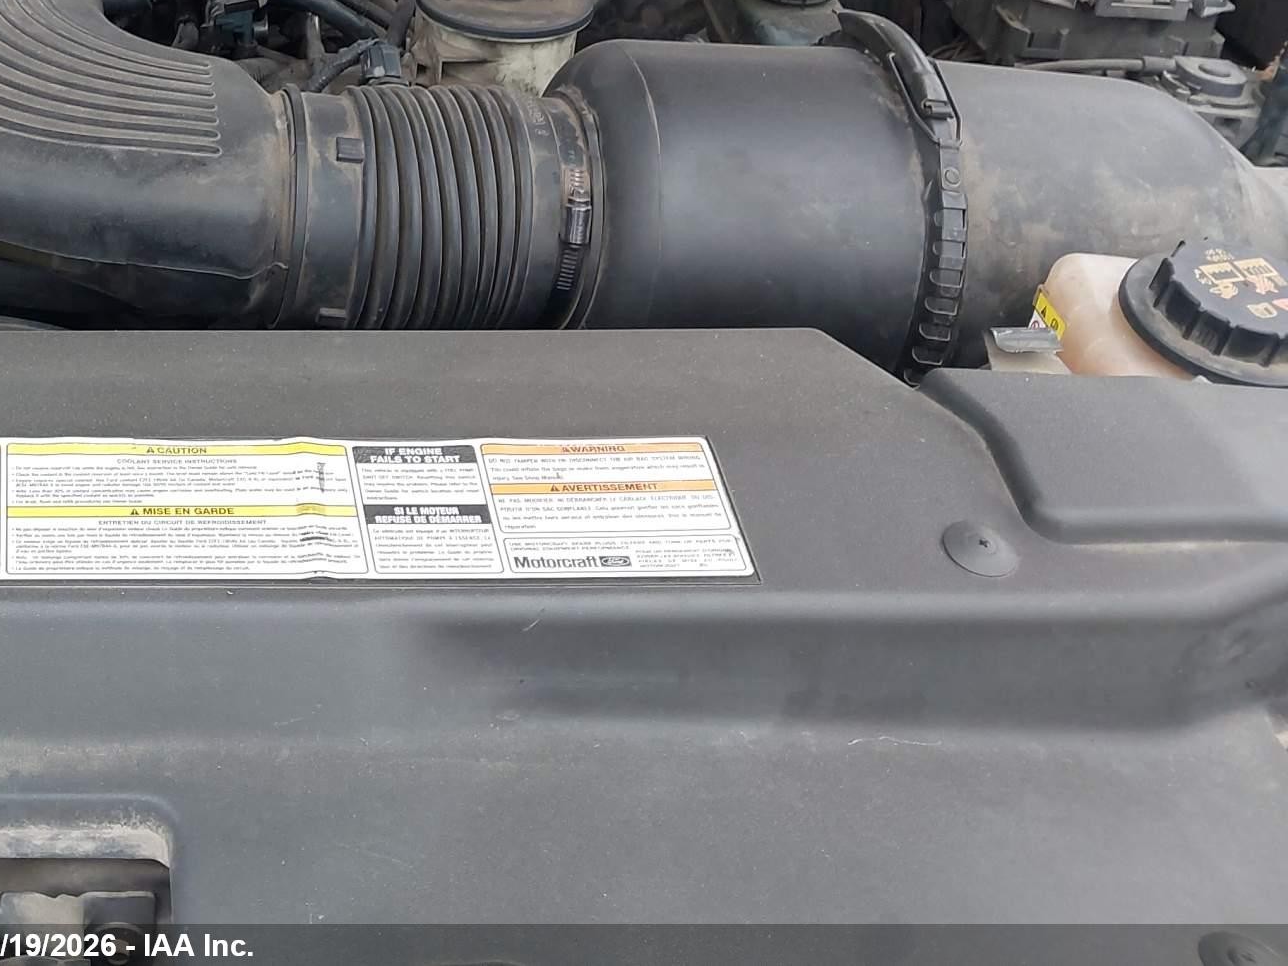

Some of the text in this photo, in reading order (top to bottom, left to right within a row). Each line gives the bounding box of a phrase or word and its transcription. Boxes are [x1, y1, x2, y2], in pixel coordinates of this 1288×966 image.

[157, 446, 208, 454] CAUTION
[384, 447, 443, 456] IF ENGINE
[571, 445, 625, 453] WARNING
[370, 455, 461, 464] FAILS TO START
[561, 483, 657, 492] AVERTISSEMENT
[142, 507, 235, 515] MISE EN GARDE
[419, 506, 460, 515] MOTEUR
[374, 514, 413, 524] REFUSE
[513, 555, 599, 569] Motorcraft
